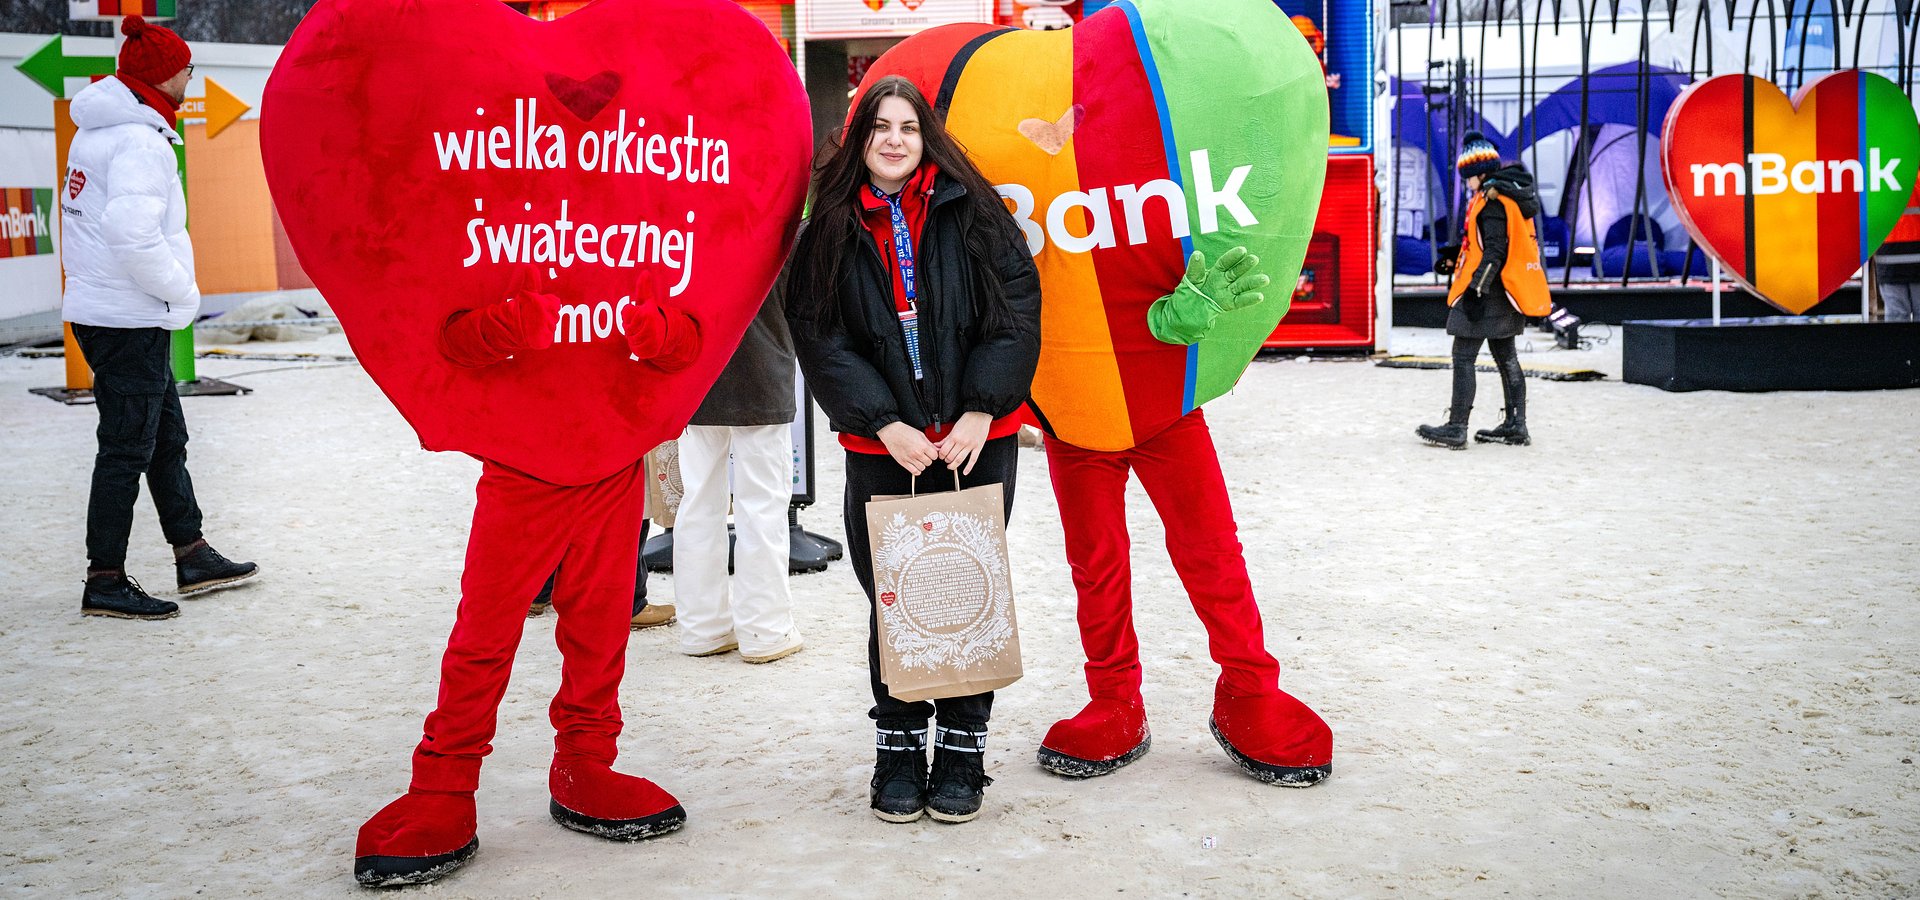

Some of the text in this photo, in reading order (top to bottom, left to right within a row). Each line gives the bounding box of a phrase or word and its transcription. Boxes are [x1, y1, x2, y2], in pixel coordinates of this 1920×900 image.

[434, 98, 729, 184] wielka orkiestra
[1691, 149, 1900, 196] mBank
[463, 198, 695, 297] świątecznej
[992, 149, 1259, 257] Bank
